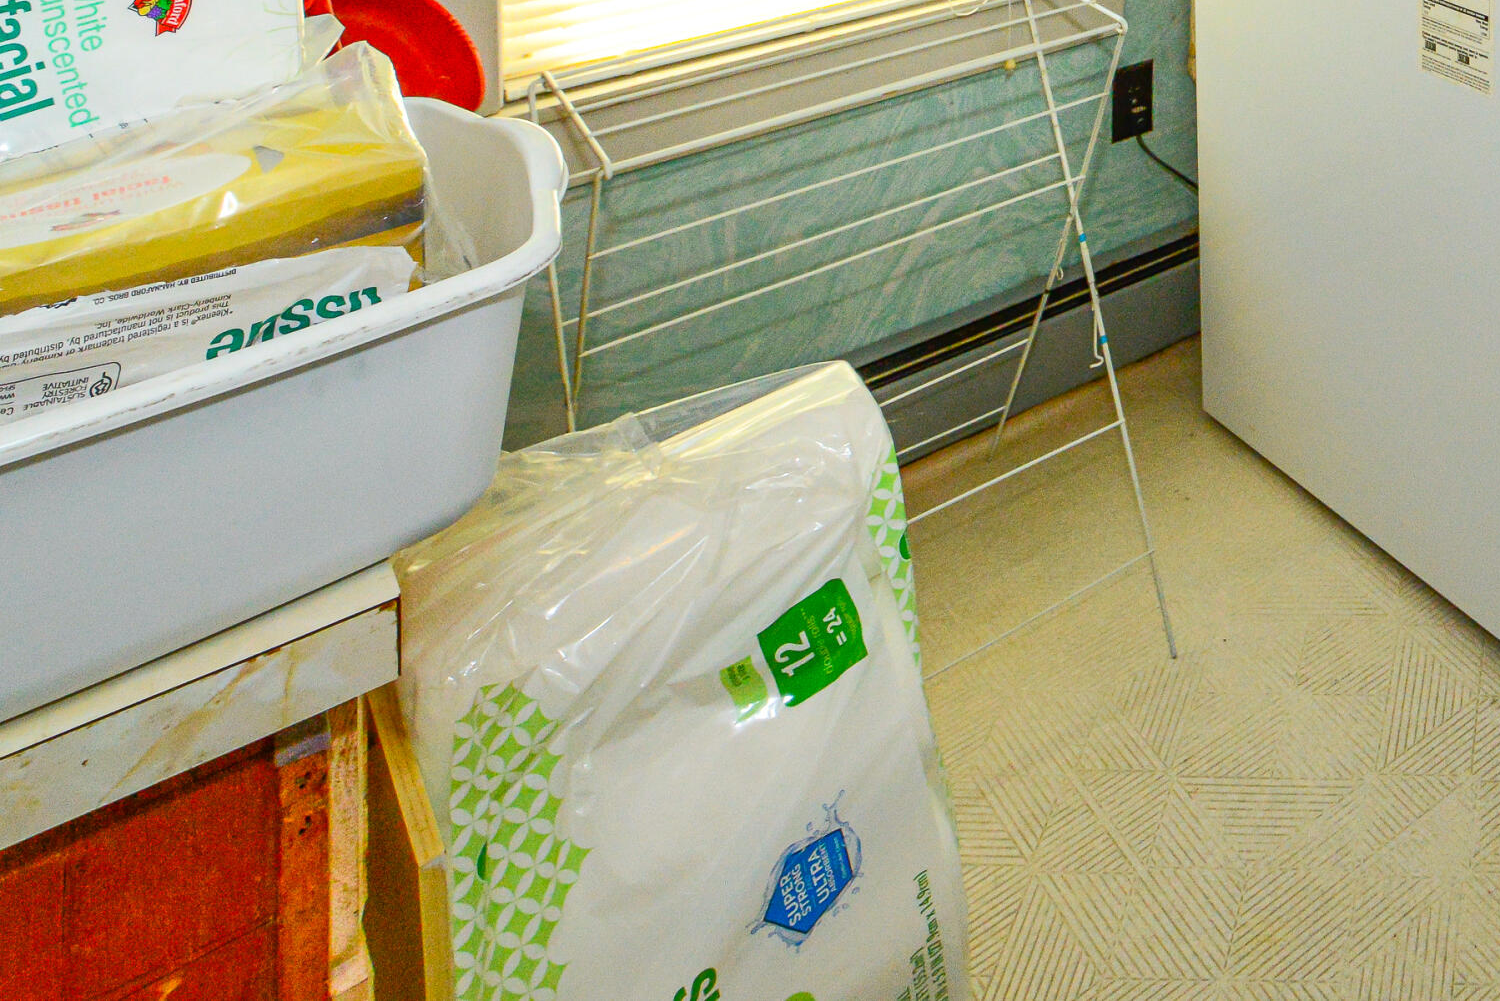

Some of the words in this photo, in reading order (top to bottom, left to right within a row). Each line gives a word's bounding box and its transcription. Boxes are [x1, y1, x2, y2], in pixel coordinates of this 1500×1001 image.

[177, 279, 189, 287] BY:
[190, 268, 237, 283] DISTRIBUTED
[93, 296, 105, 305] CO.
[108, 291, 129, 302] BROS.
[166, 314, 173, 322] is
[175, 304, 210, 318] product
[94, 320, 111, 330] Inc.
[148, 317, 163, 326] not
[182, 318, 189, 327] is
[83, 320, 146, 343] manufactured
[128, 322, 172, 342] registered
[78, 336, 125, 352] trademark
[13, 342, 64, 363] distributed
[42, 376, 89, 391] INITIATIVE
[822, 606, 843, 634] 24
[775, 630, 816, 677] 12
[818, 842, 837, 892] ABSORBENT
[807, 847, 830, 904] ULTRA
[791, 863, 812, 917] STRONG
[779, 872, 802, 927] SUPER
